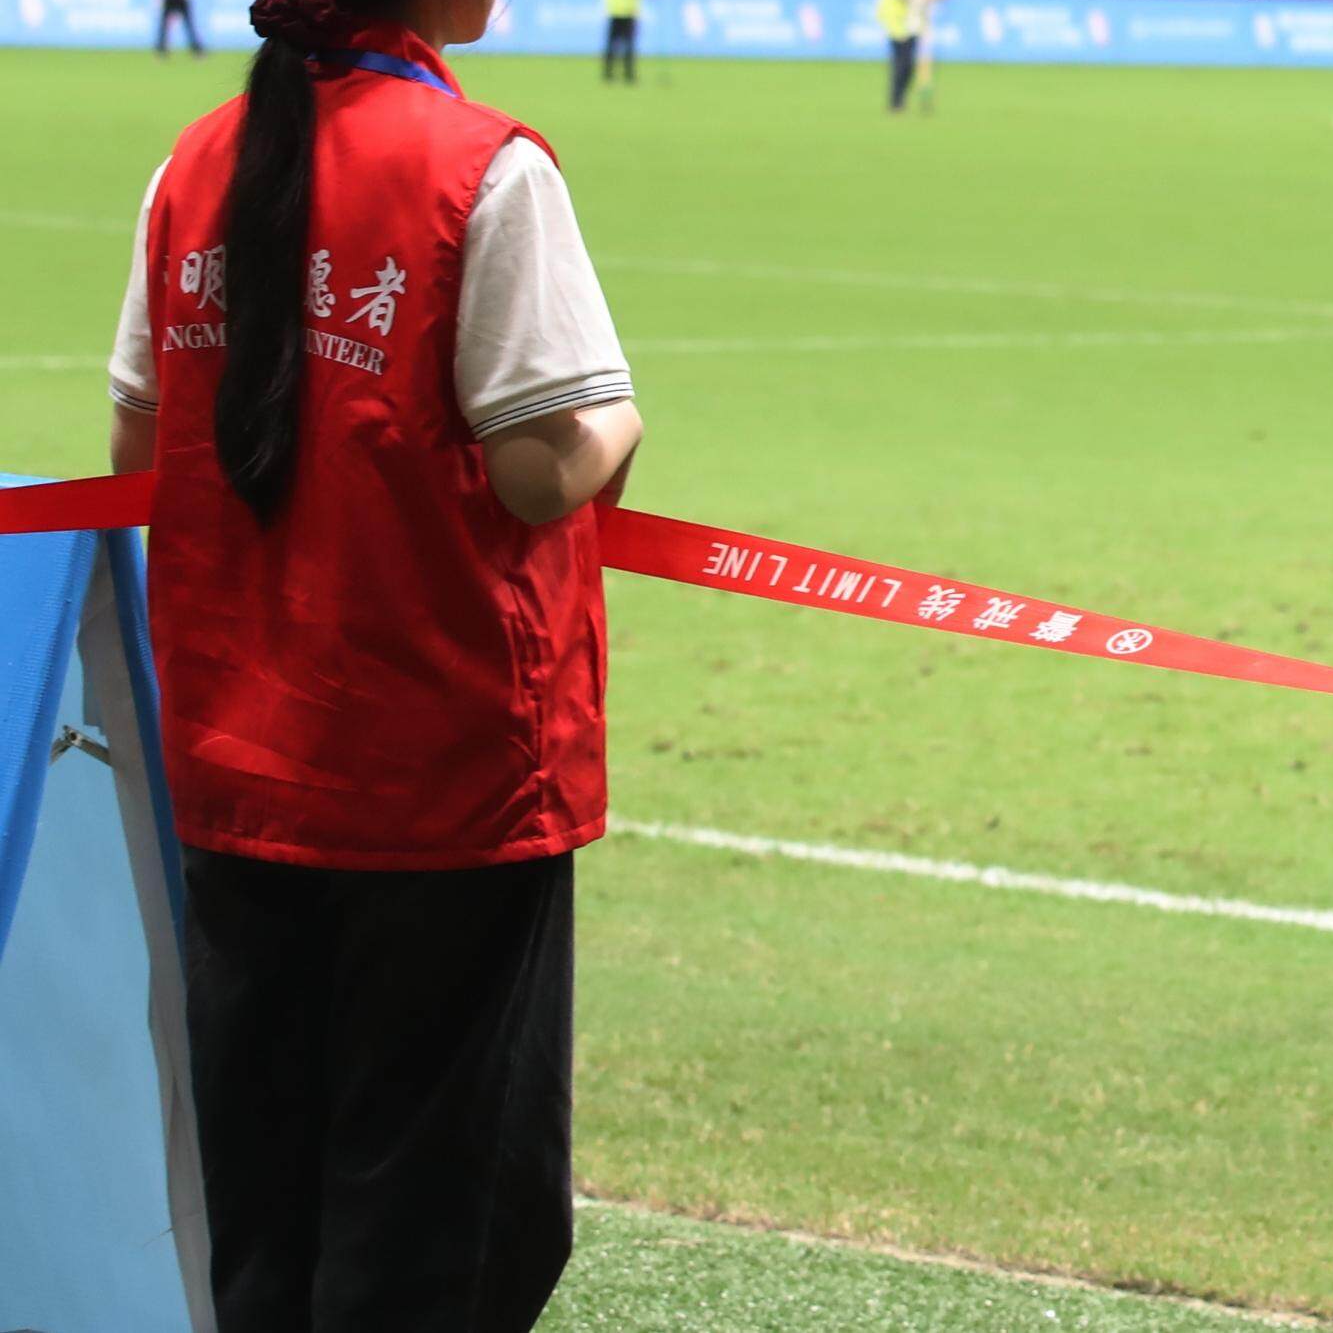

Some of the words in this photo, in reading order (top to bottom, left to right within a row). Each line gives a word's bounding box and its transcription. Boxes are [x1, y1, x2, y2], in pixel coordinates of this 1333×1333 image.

[163, 244, 406, 337] 明愿者
[305, 328, 385, 375] NTEER
[702, 542, 789, 586] LINE
[791, 564, 903, 608] LIMIT
[917, 584, 1083, 643] 警戒线
